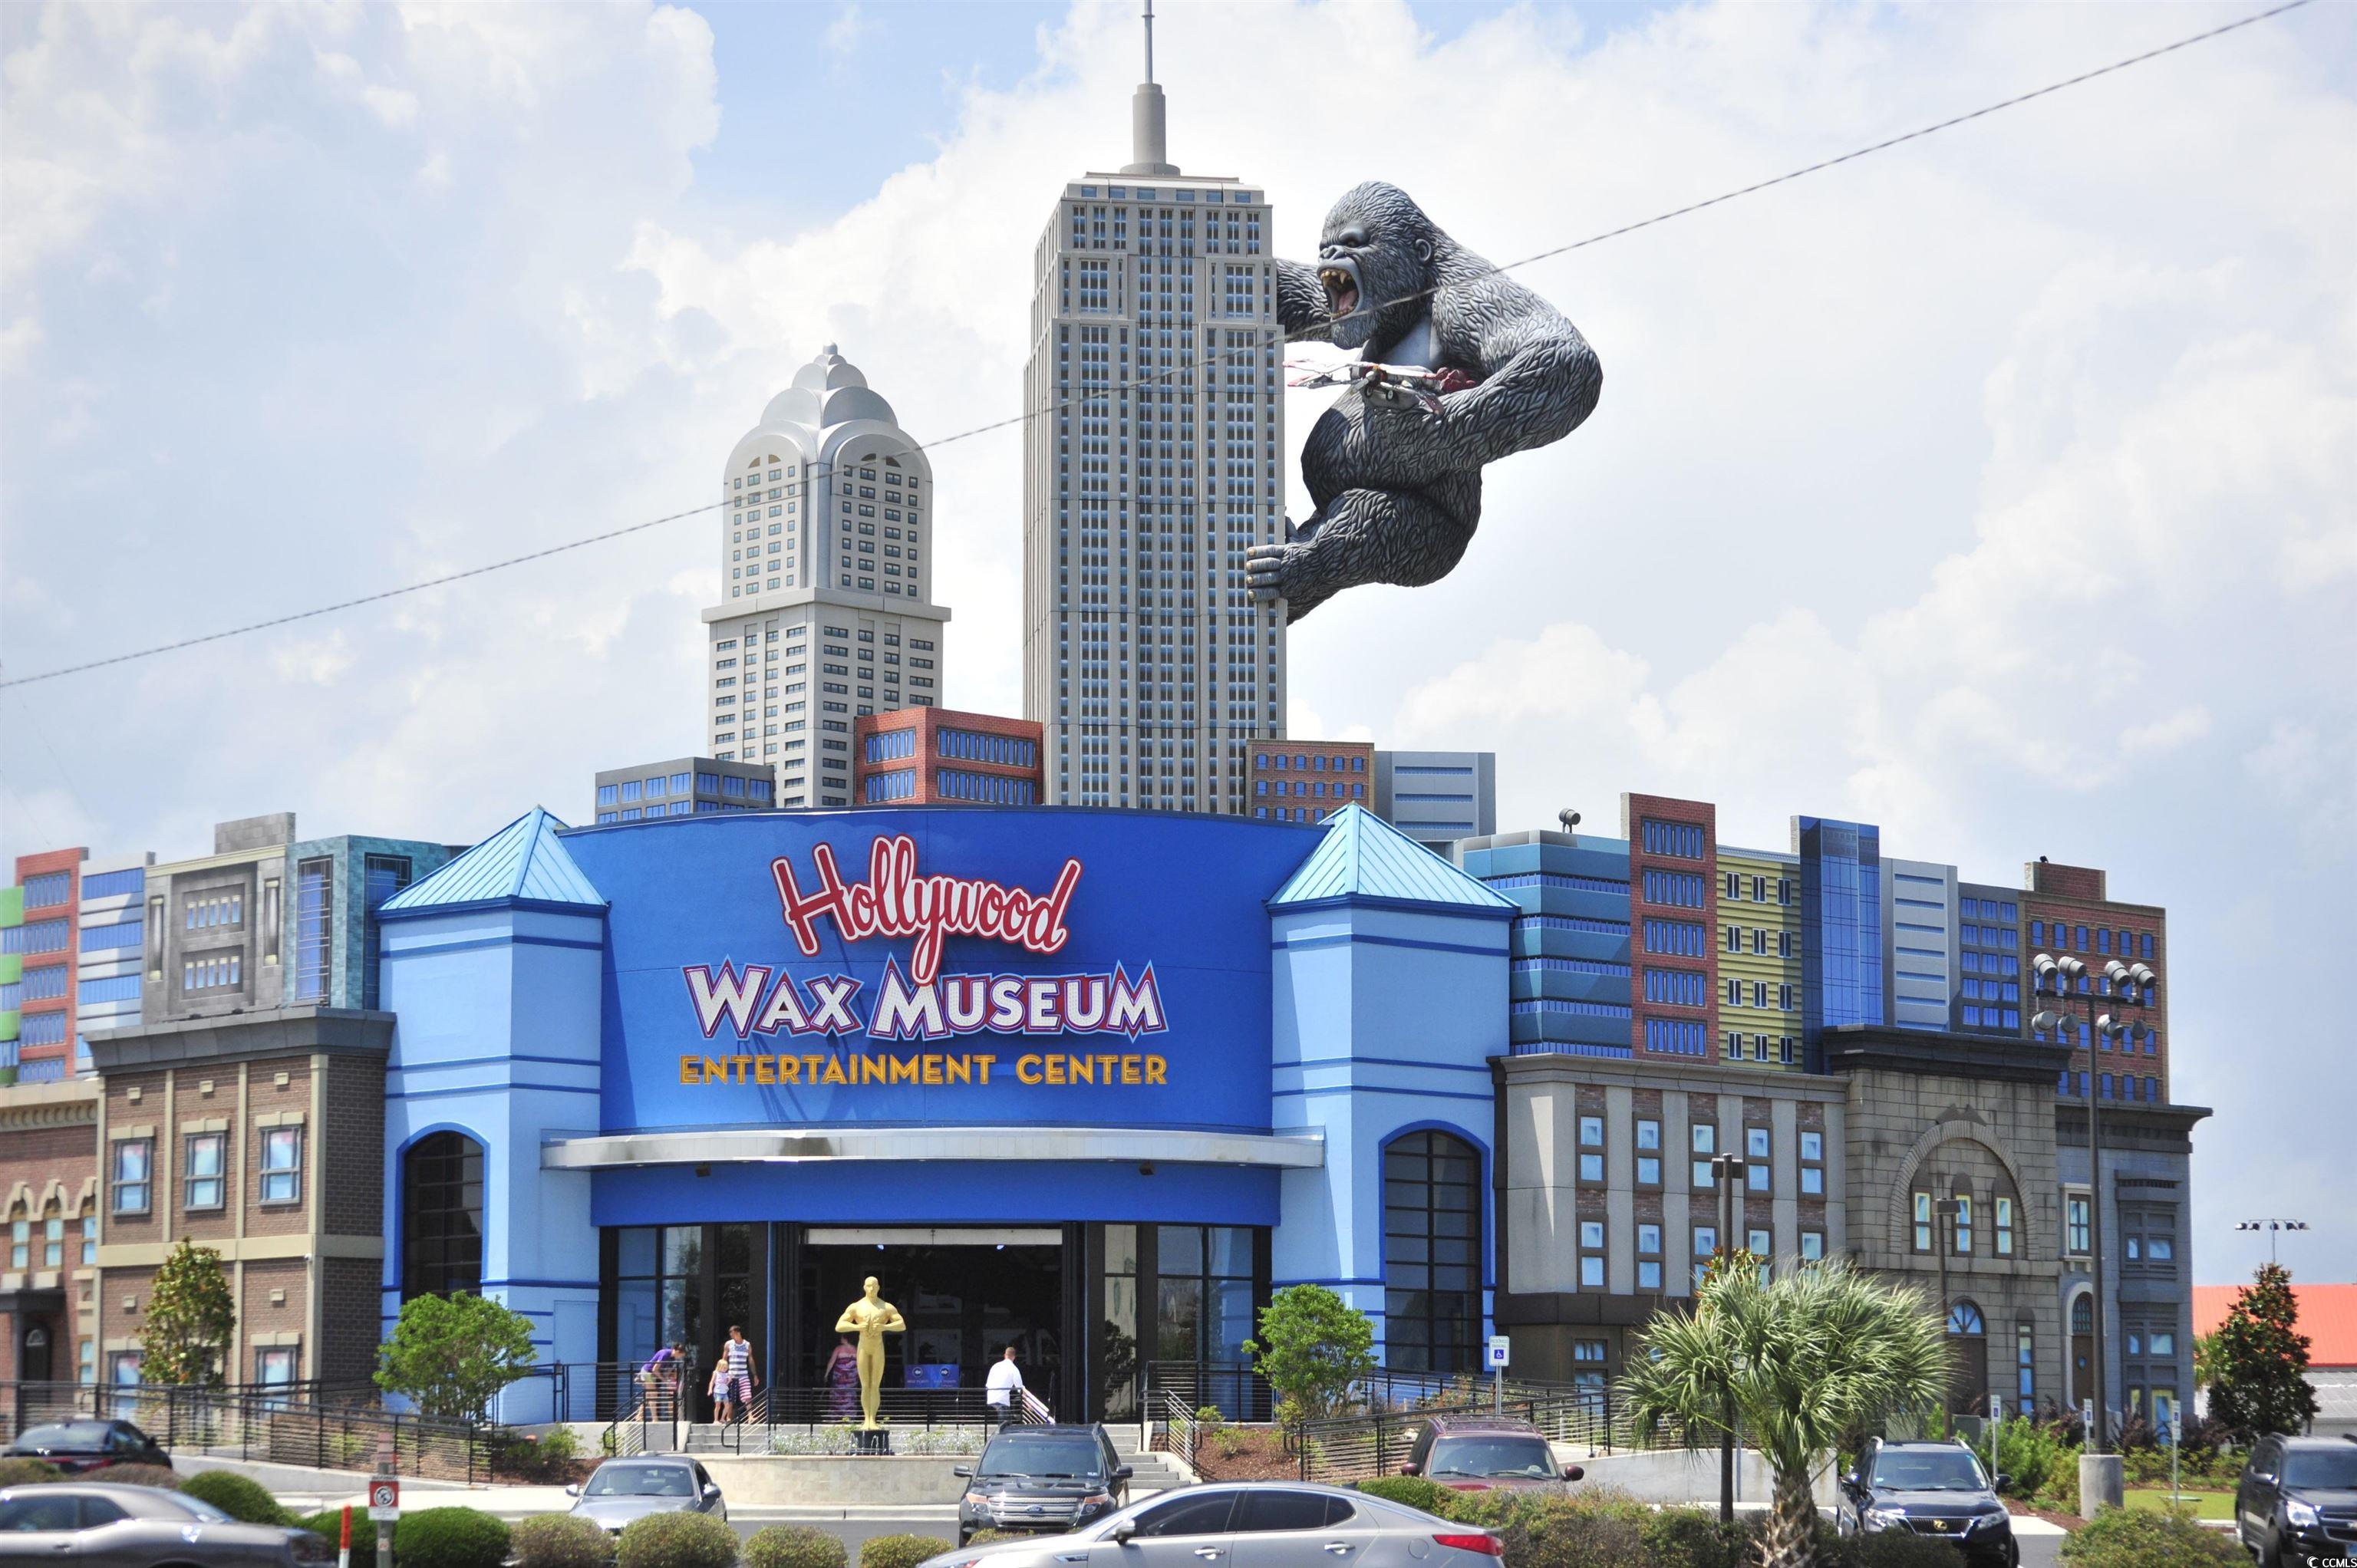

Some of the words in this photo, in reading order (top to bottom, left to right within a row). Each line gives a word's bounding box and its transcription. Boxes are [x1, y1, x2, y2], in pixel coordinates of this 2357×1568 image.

[771, 834, 1082, 985] Hollywood
[682, 954, 864, 1039] WAX
[867, 952, 1169, 1043] MUSEUM
[680, 1053, 995, 1085] ENTERTAINMENT
[1016, 1053, 1168, 1085] CENTER
